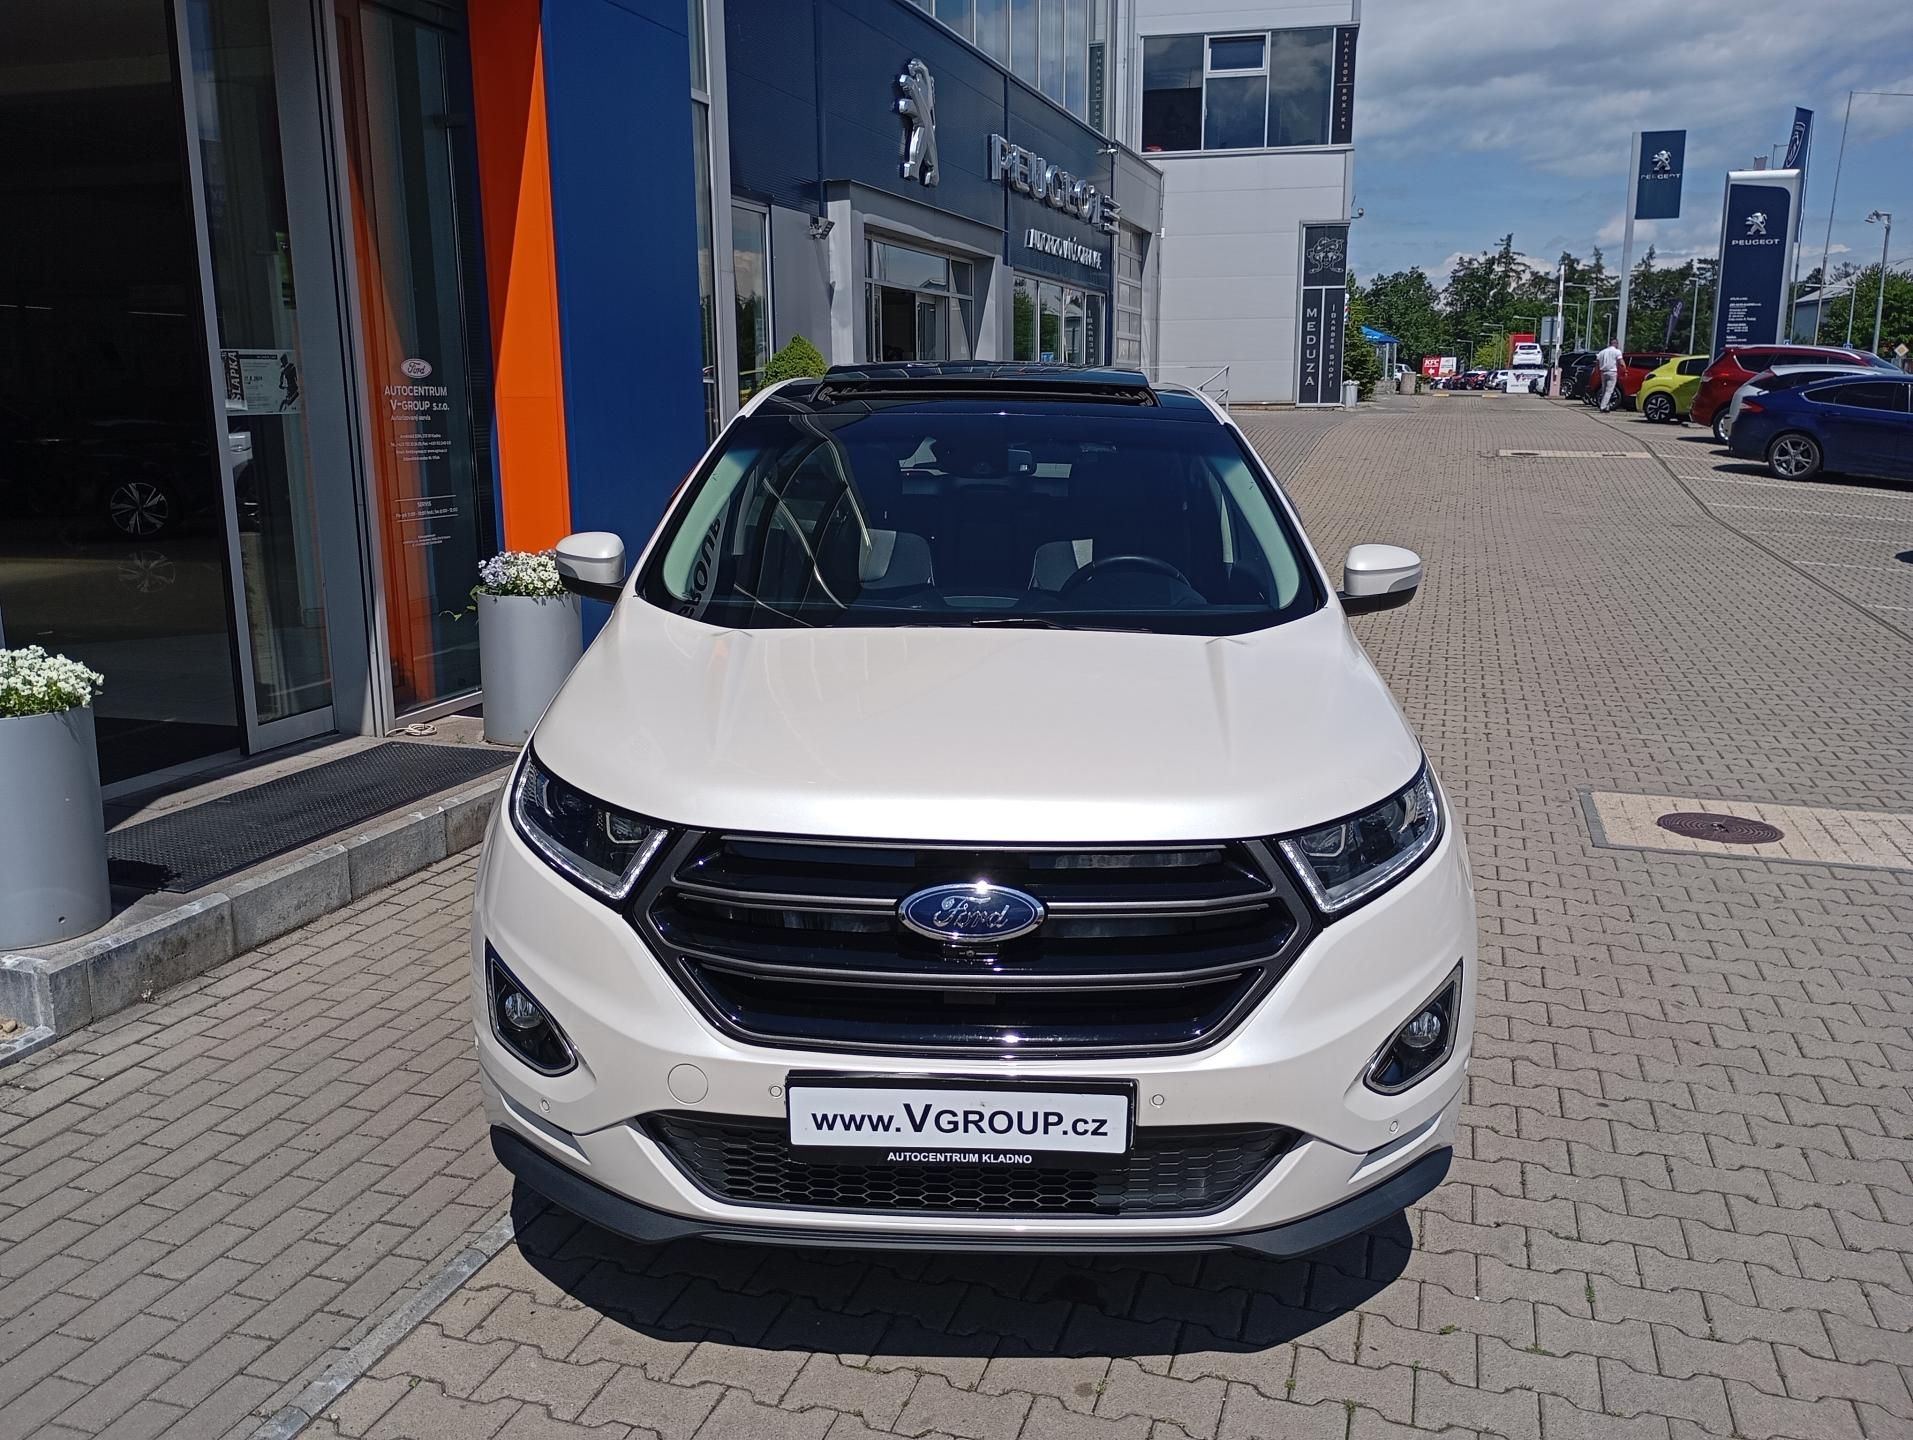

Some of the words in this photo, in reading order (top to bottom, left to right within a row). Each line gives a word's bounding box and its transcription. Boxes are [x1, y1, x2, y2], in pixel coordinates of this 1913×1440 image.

[1342, 32, 1350, 82] THAIBOX
[1304, 307, 1318, 386] MEDUZA
[407, 361, 426, 375] Ford
[384, 385, 448, 396] AUTOCENTRUM
[390, 400, 431, 411] V-GROUP
[432, 402, 450, 411] s.r.o.
[932, 895, 1010, 928] Ford
[811, 1102, 1109, 1137] www.VGROUP.cz
[886, 1151, 980, 1164] AUTOCENTRUM
[981, 1153, 1033, 1165] KLADNO
